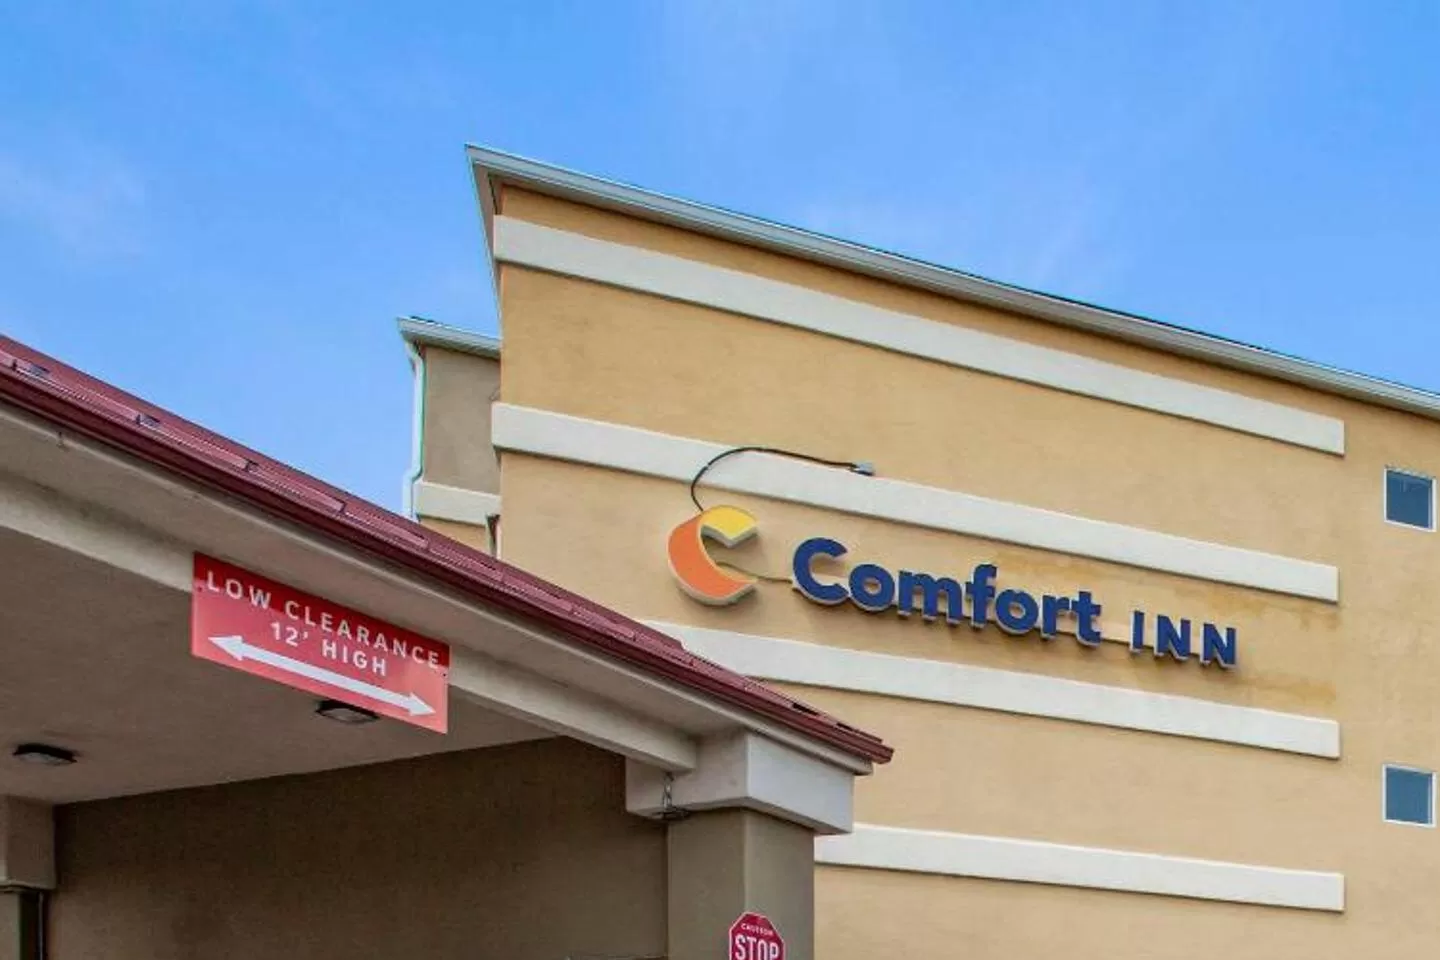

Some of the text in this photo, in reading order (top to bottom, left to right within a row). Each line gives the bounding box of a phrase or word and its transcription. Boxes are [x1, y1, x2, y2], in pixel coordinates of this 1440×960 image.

[206, 570, 440, 669] LOW CLEARANCE
[271, 621, 387, 677] 12' HIGH
[792, 537, 1238, 669] Comfort INN
